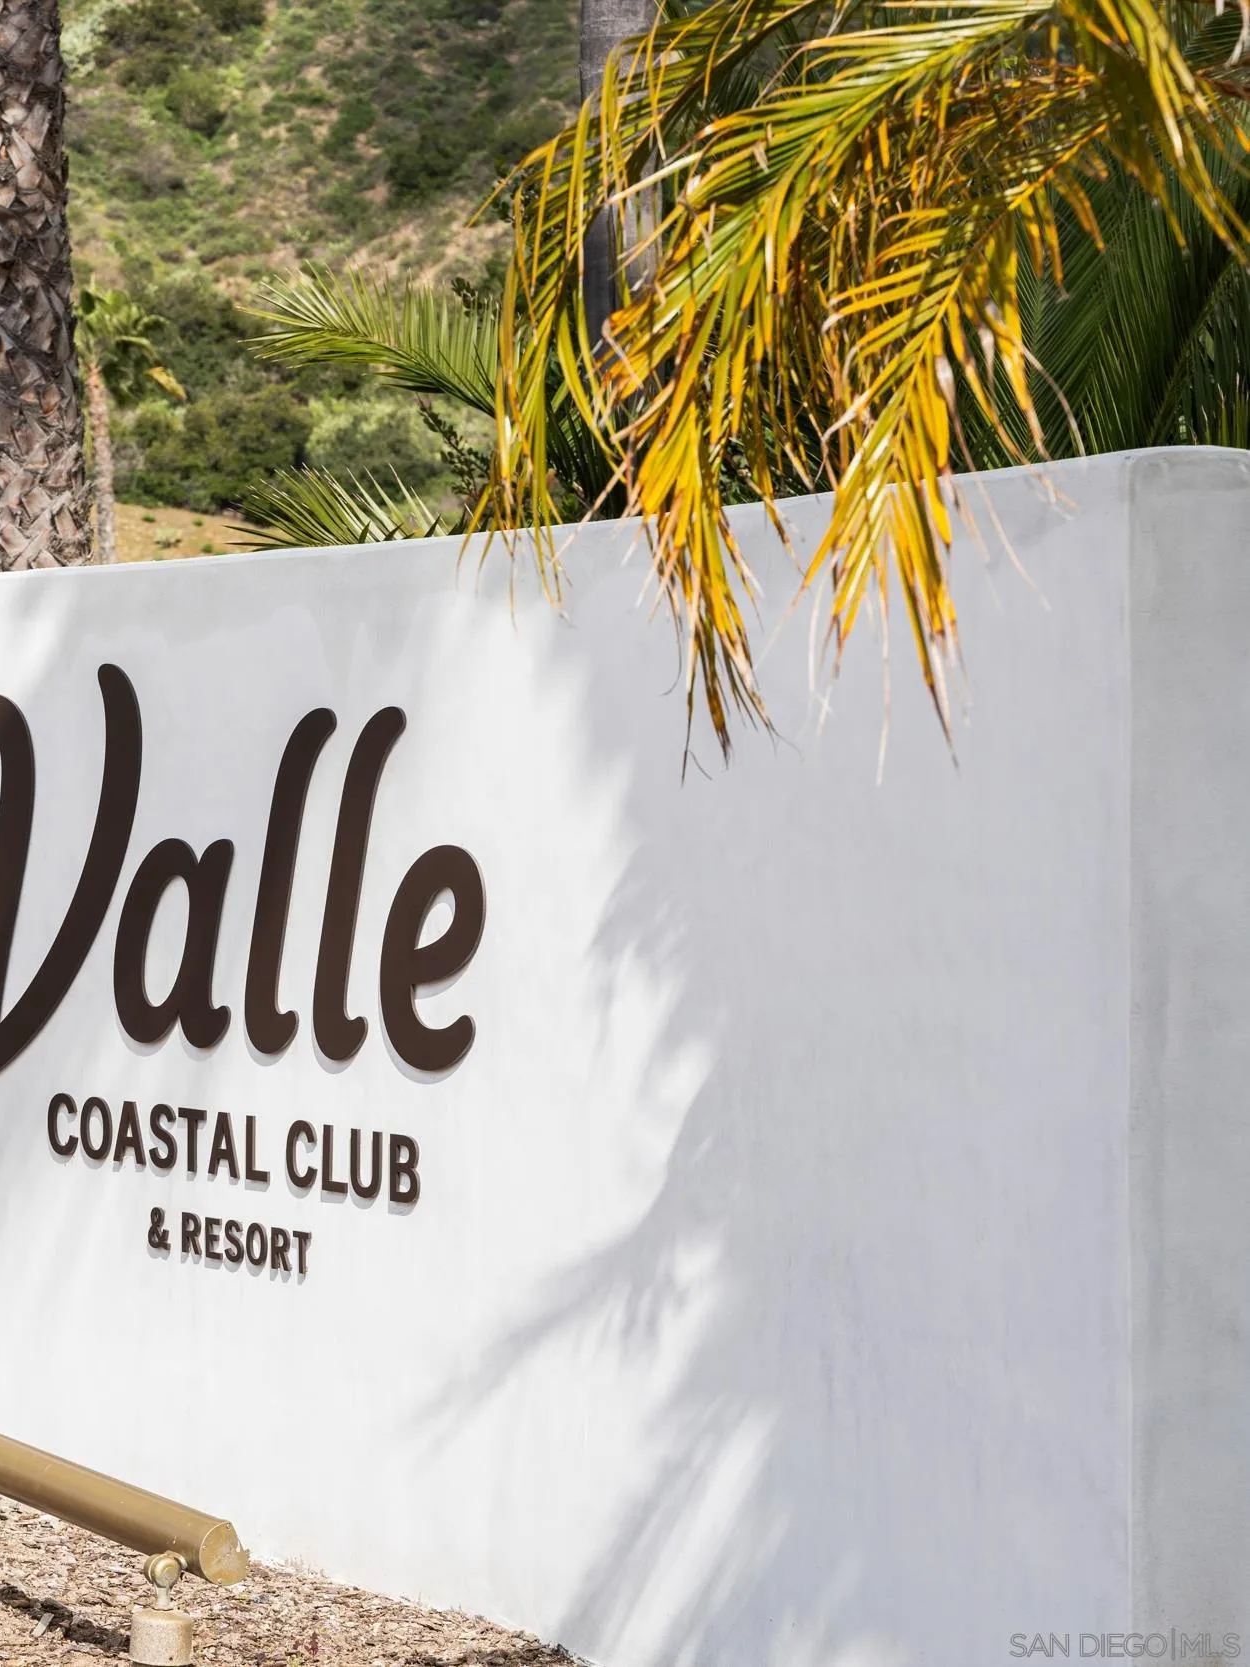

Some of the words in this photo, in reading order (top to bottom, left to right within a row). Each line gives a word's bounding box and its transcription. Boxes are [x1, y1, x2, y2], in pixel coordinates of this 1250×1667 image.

[47, 1092, 271, 1184] COASTAL
[285, 1119, 421, 1205] CLUB
[147, 1206, 171, 1251] &
[181, 1211, 312, 1275] RESORT
